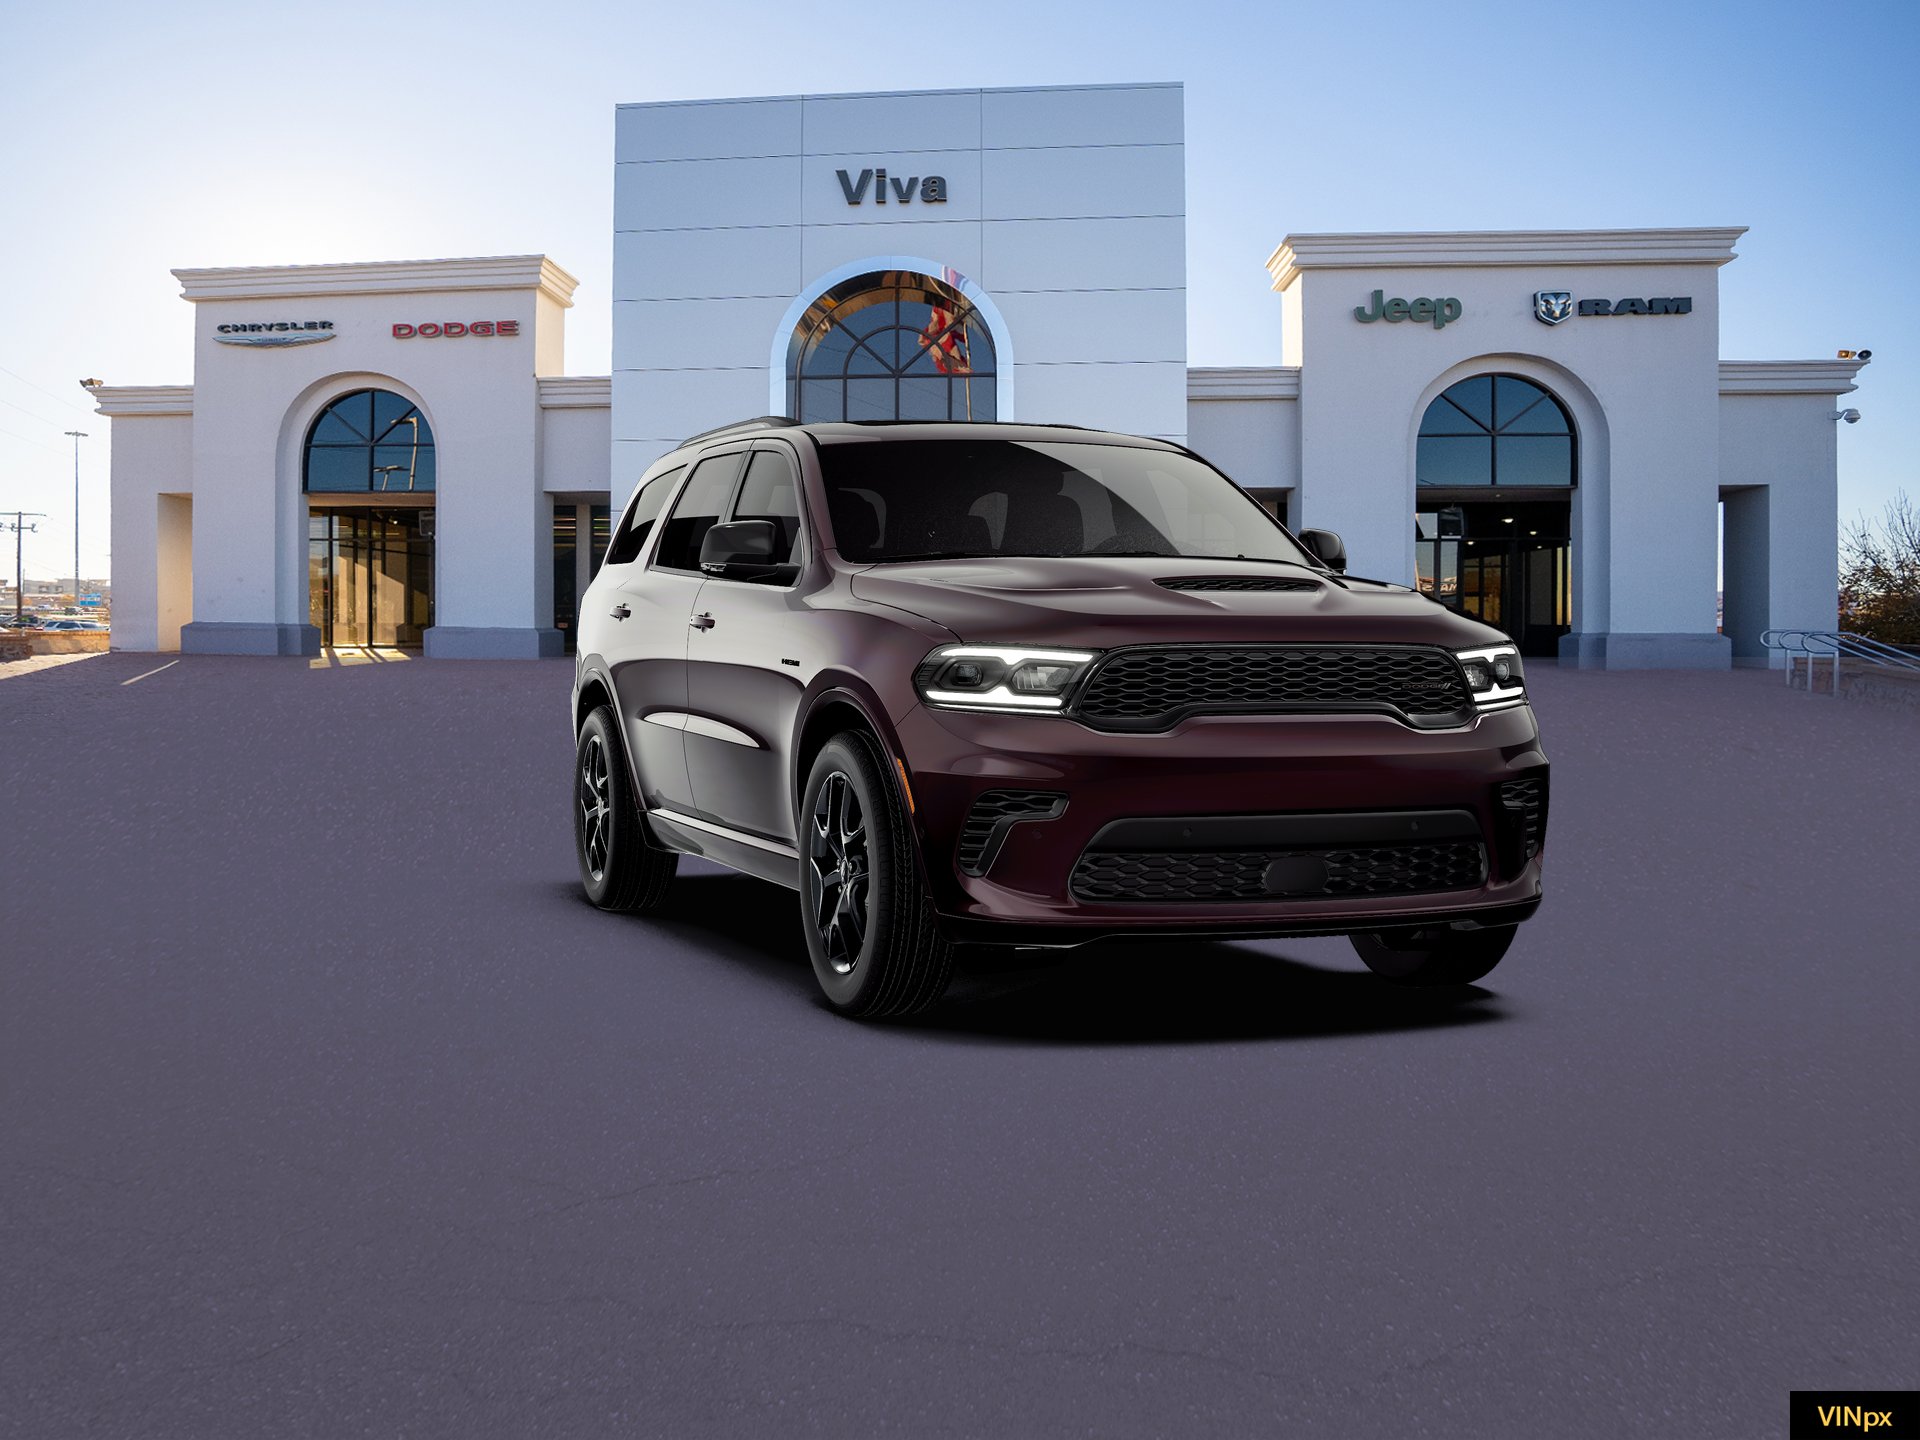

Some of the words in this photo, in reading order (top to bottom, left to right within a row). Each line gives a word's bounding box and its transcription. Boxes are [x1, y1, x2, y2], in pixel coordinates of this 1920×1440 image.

[835, 168, 947, 205] Viva
[1354, 290, 1462, 329] Jeep
[1579, 297, 1692, 316] RAM
[217, 321, 334, 333] CHRYSLER
[392, 320, 520, 339] DODGE
